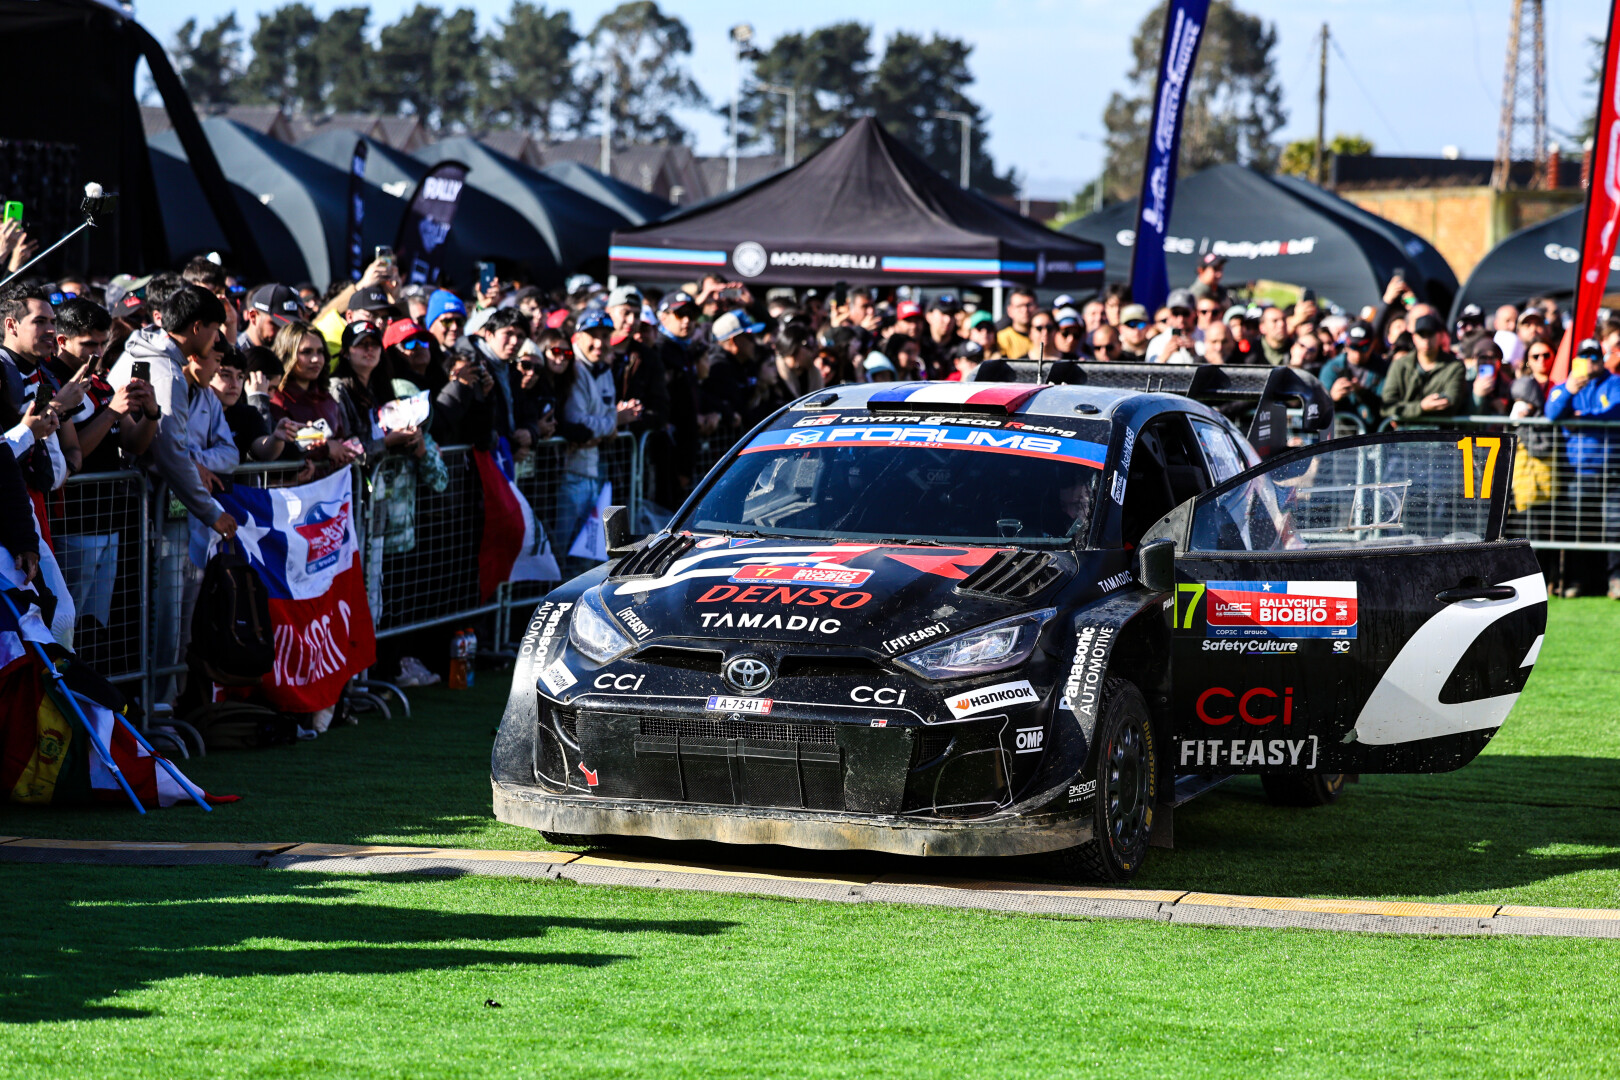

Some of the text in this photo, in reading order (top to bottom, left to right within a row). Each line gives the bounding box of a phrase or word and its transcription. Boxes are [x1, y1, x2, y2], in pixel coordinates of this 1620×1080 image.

[770, 251, 877, 270] MORBIDELLI
[841, 415, 1078, 438] TOYOTA GAZOO Racing
[826, 427, 1062, 453] FORUM8
[1457, 437, 1501, 499] 17
[755, 567, 782, 577] 17
[1098, 570, 1133, 593] TAMADIC
[696, 585, 873, 609] DENSO
[1216, 602, 1252, 611] WRC
[1259, 598, 1327, 608] RALLYCHILE
[701, 613, 842, 634] TAMADIC
[1202, 640, 1298, 655] SafetyCulture
[1332, 640, 1350, 652] SC
[1059, 626, 1096, 711] Panasonic
[1080, 626, 1114, 716] AUTOMOTIVE
[593, 672, 646, 691] CCi
[719, 698, 759, 710] A-7541
[850, 685, 907, 705] CCi
[1196, 687, 1294, 726] CCi
[1015, 730, 1044, 749] OMP
